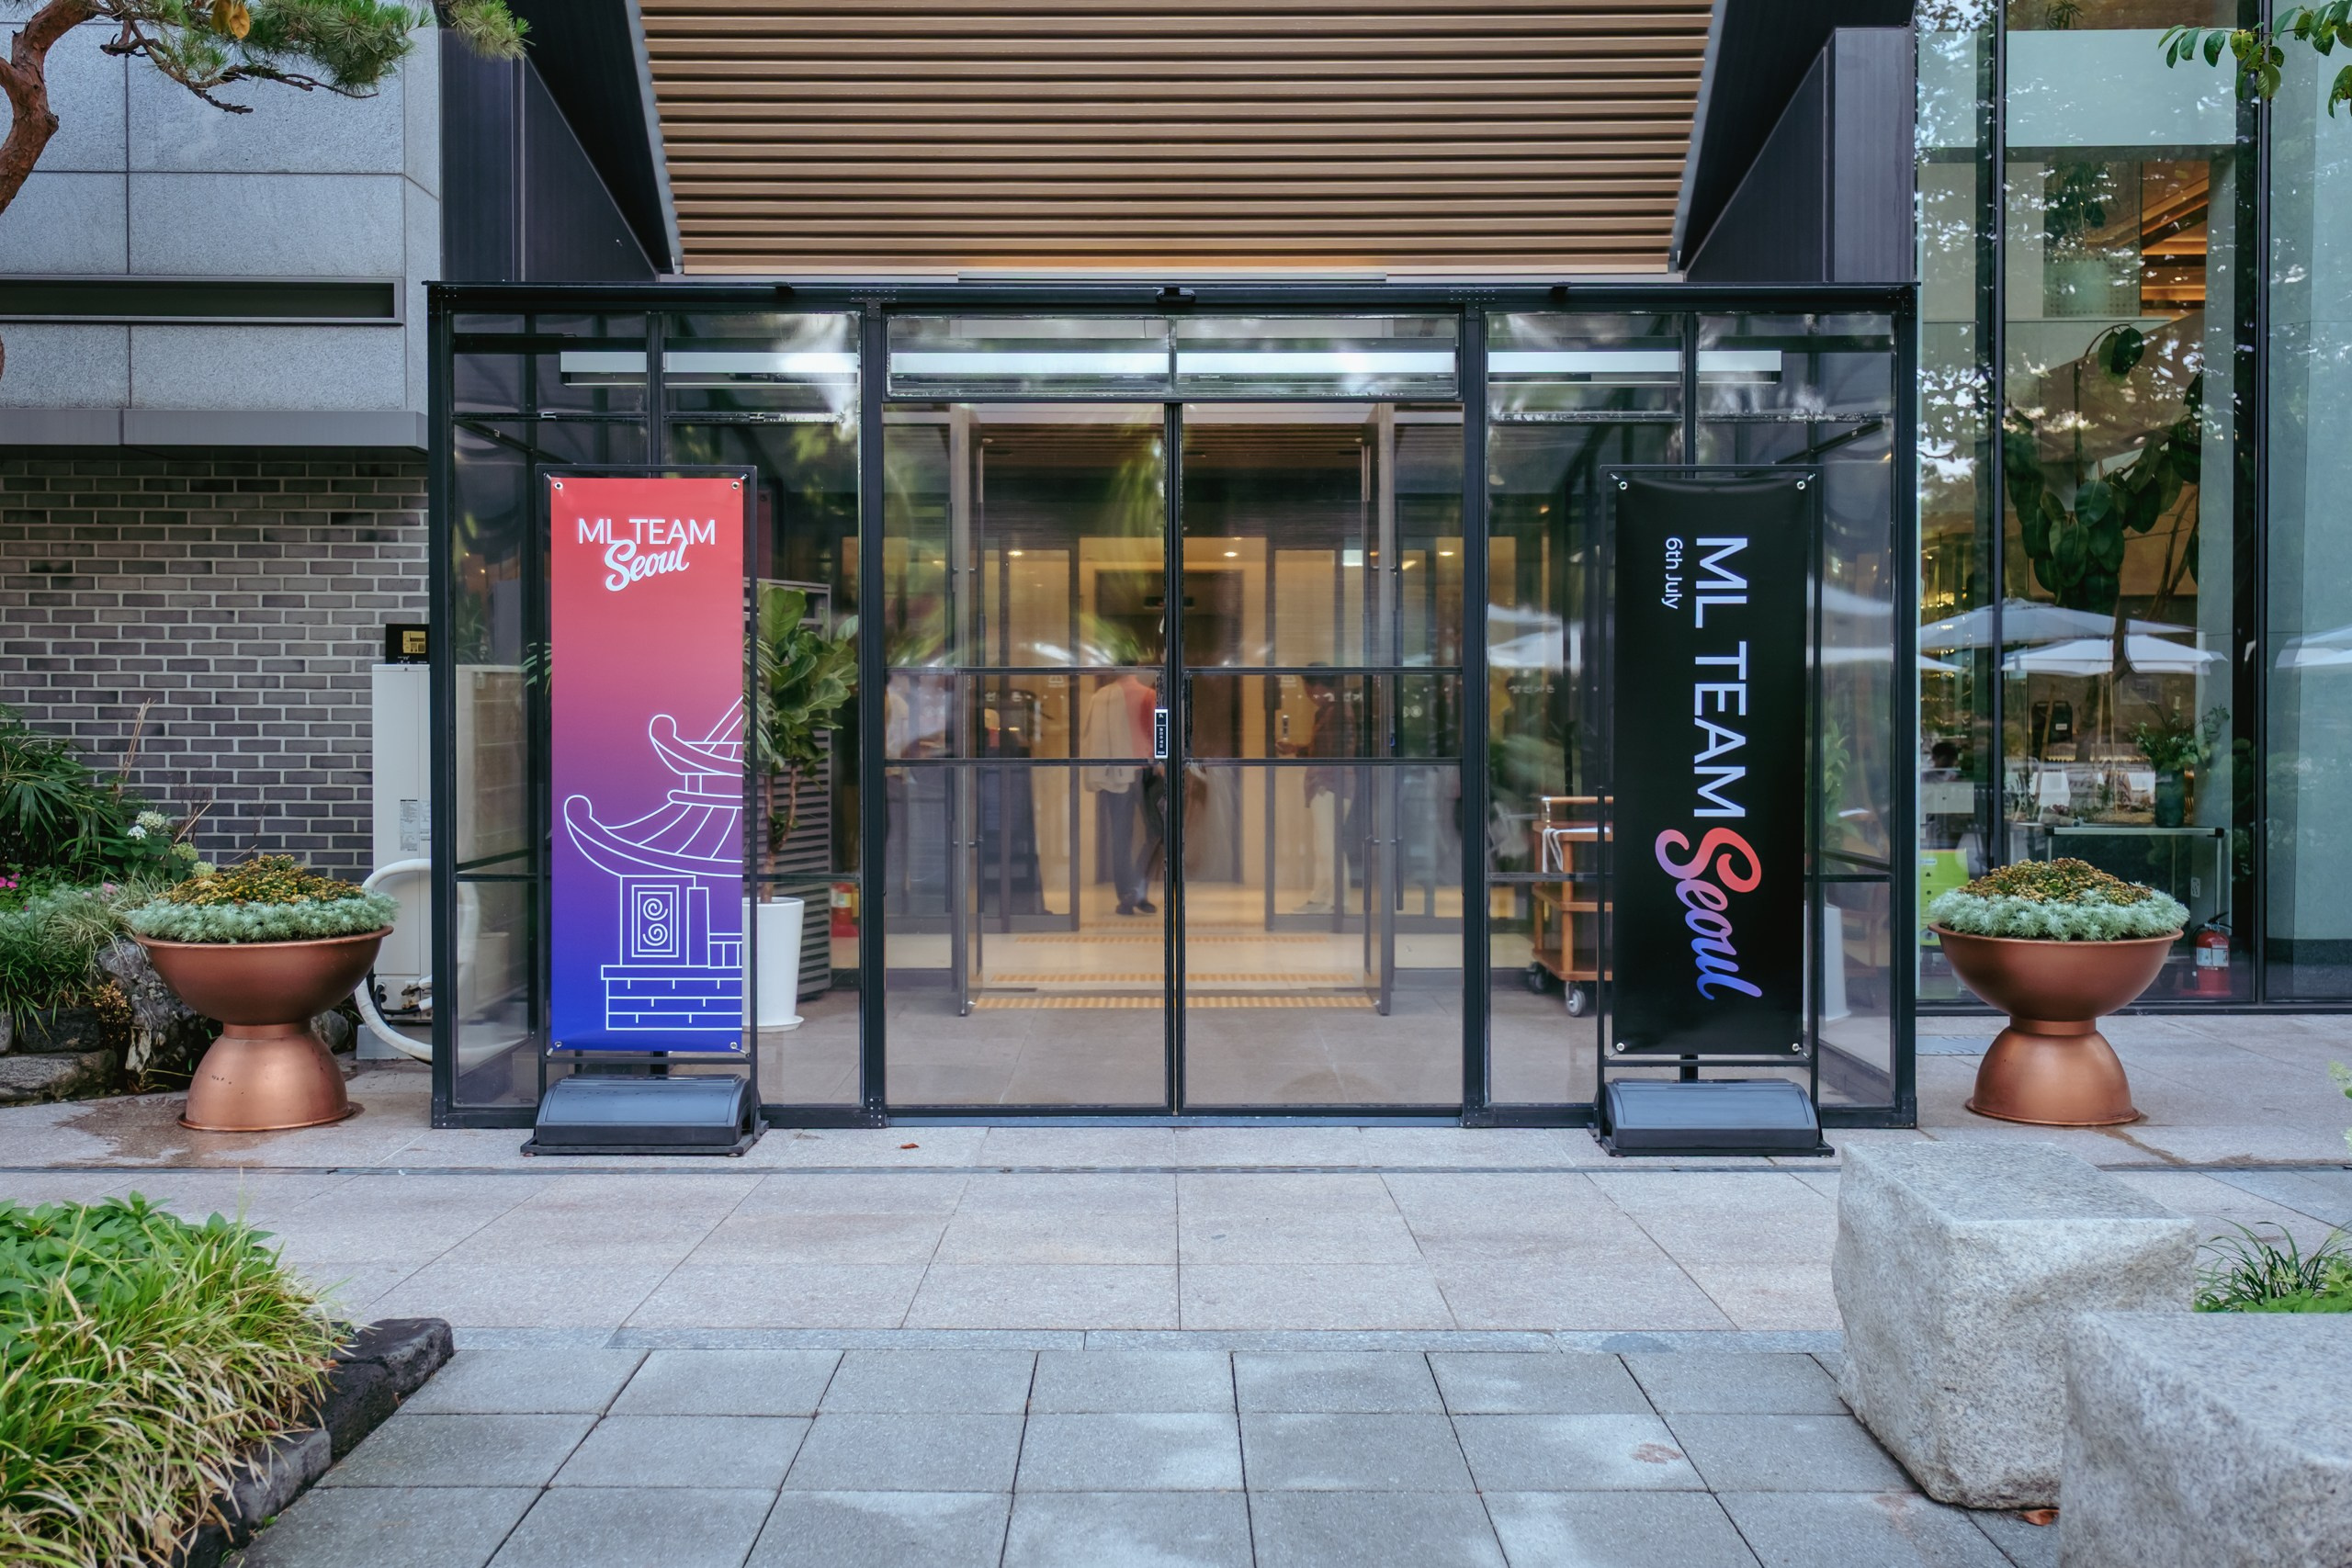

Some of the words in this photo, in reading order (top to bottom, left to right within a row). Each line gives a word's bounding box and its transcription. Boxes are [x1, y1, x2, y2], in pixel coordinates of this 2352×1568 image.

[578, 518, 616, 545] ML
[628, 518, 716, 546] TEAM
[1665, 536, 1684, 570] 6th
[604, 539, 690, 592] Seoul
[1660, 572, 1683, 610] July
[1694, 536, 1748, 629] ML
[1693, 640, 1747, 818] TEAM
[1655, 827, 1763, 1000] Seoul
